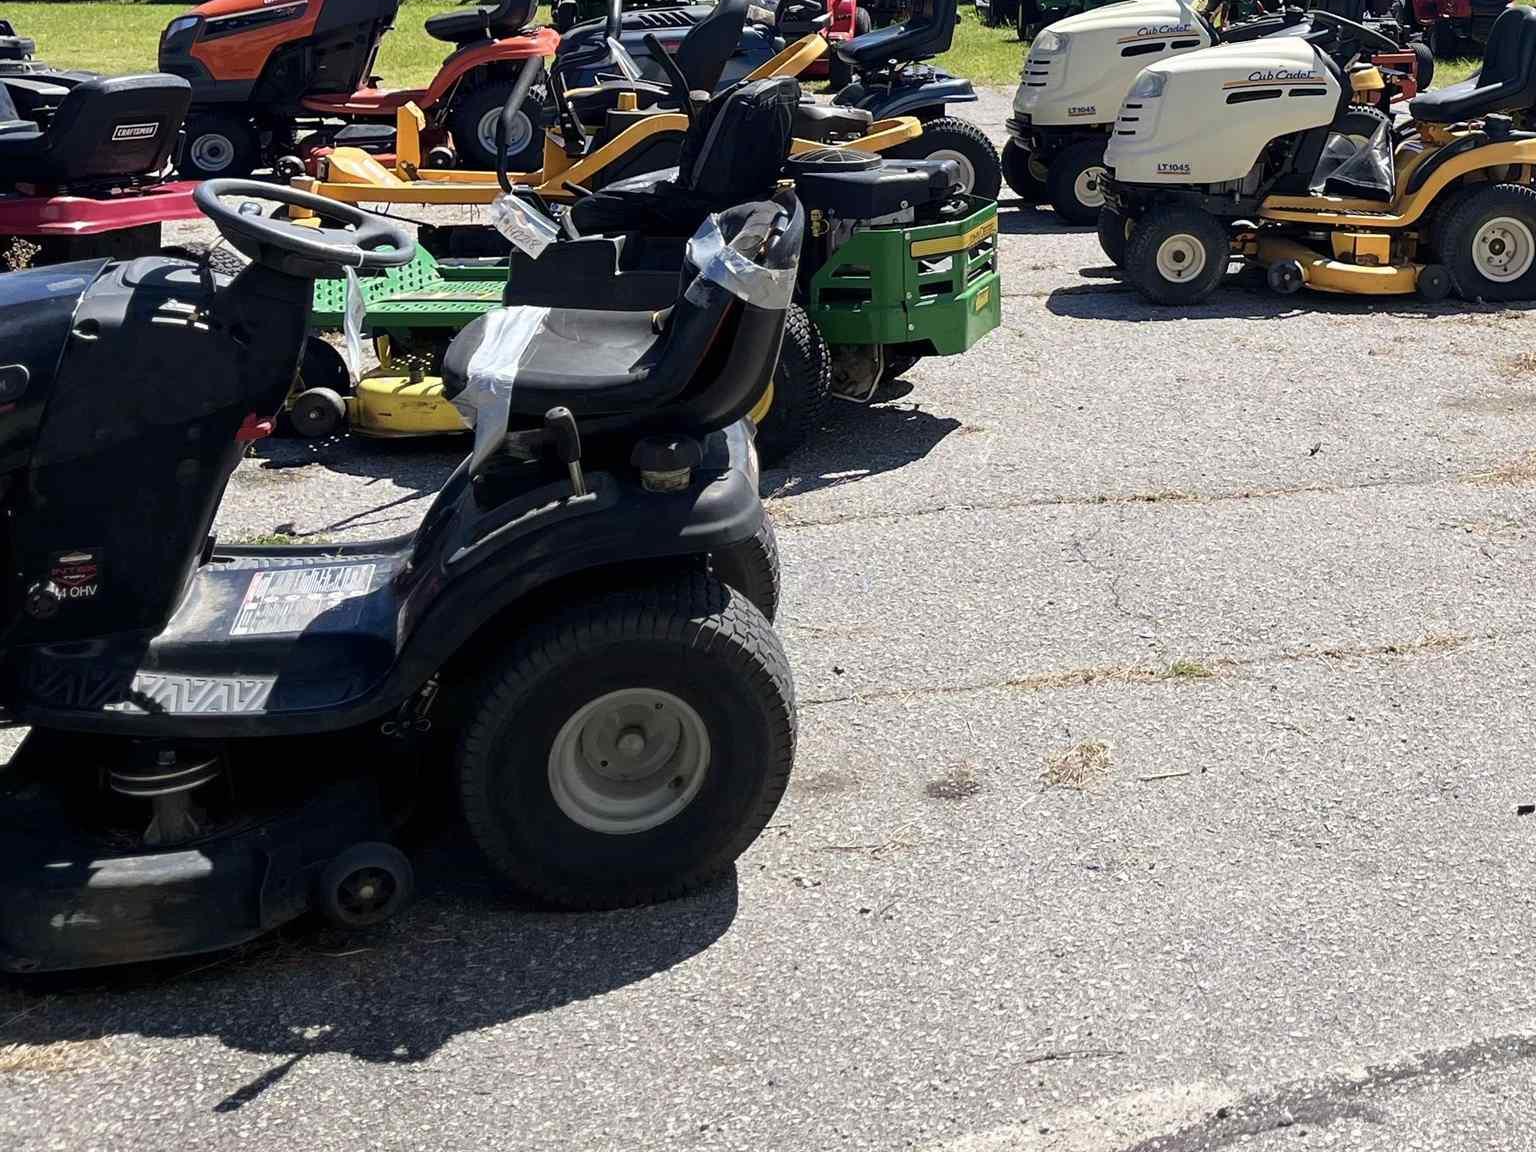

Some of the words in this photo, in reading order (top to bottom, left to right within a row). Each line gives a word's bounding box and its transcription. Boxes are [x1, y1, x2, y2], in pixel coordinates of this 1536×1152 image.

[1248, 70, 1274, 81] Cub
[1275, 69, 1317, 80] Cadet
[117, 127, 154, 137] CRAFTSMAN
[70, 584, 98, 598] OHV
